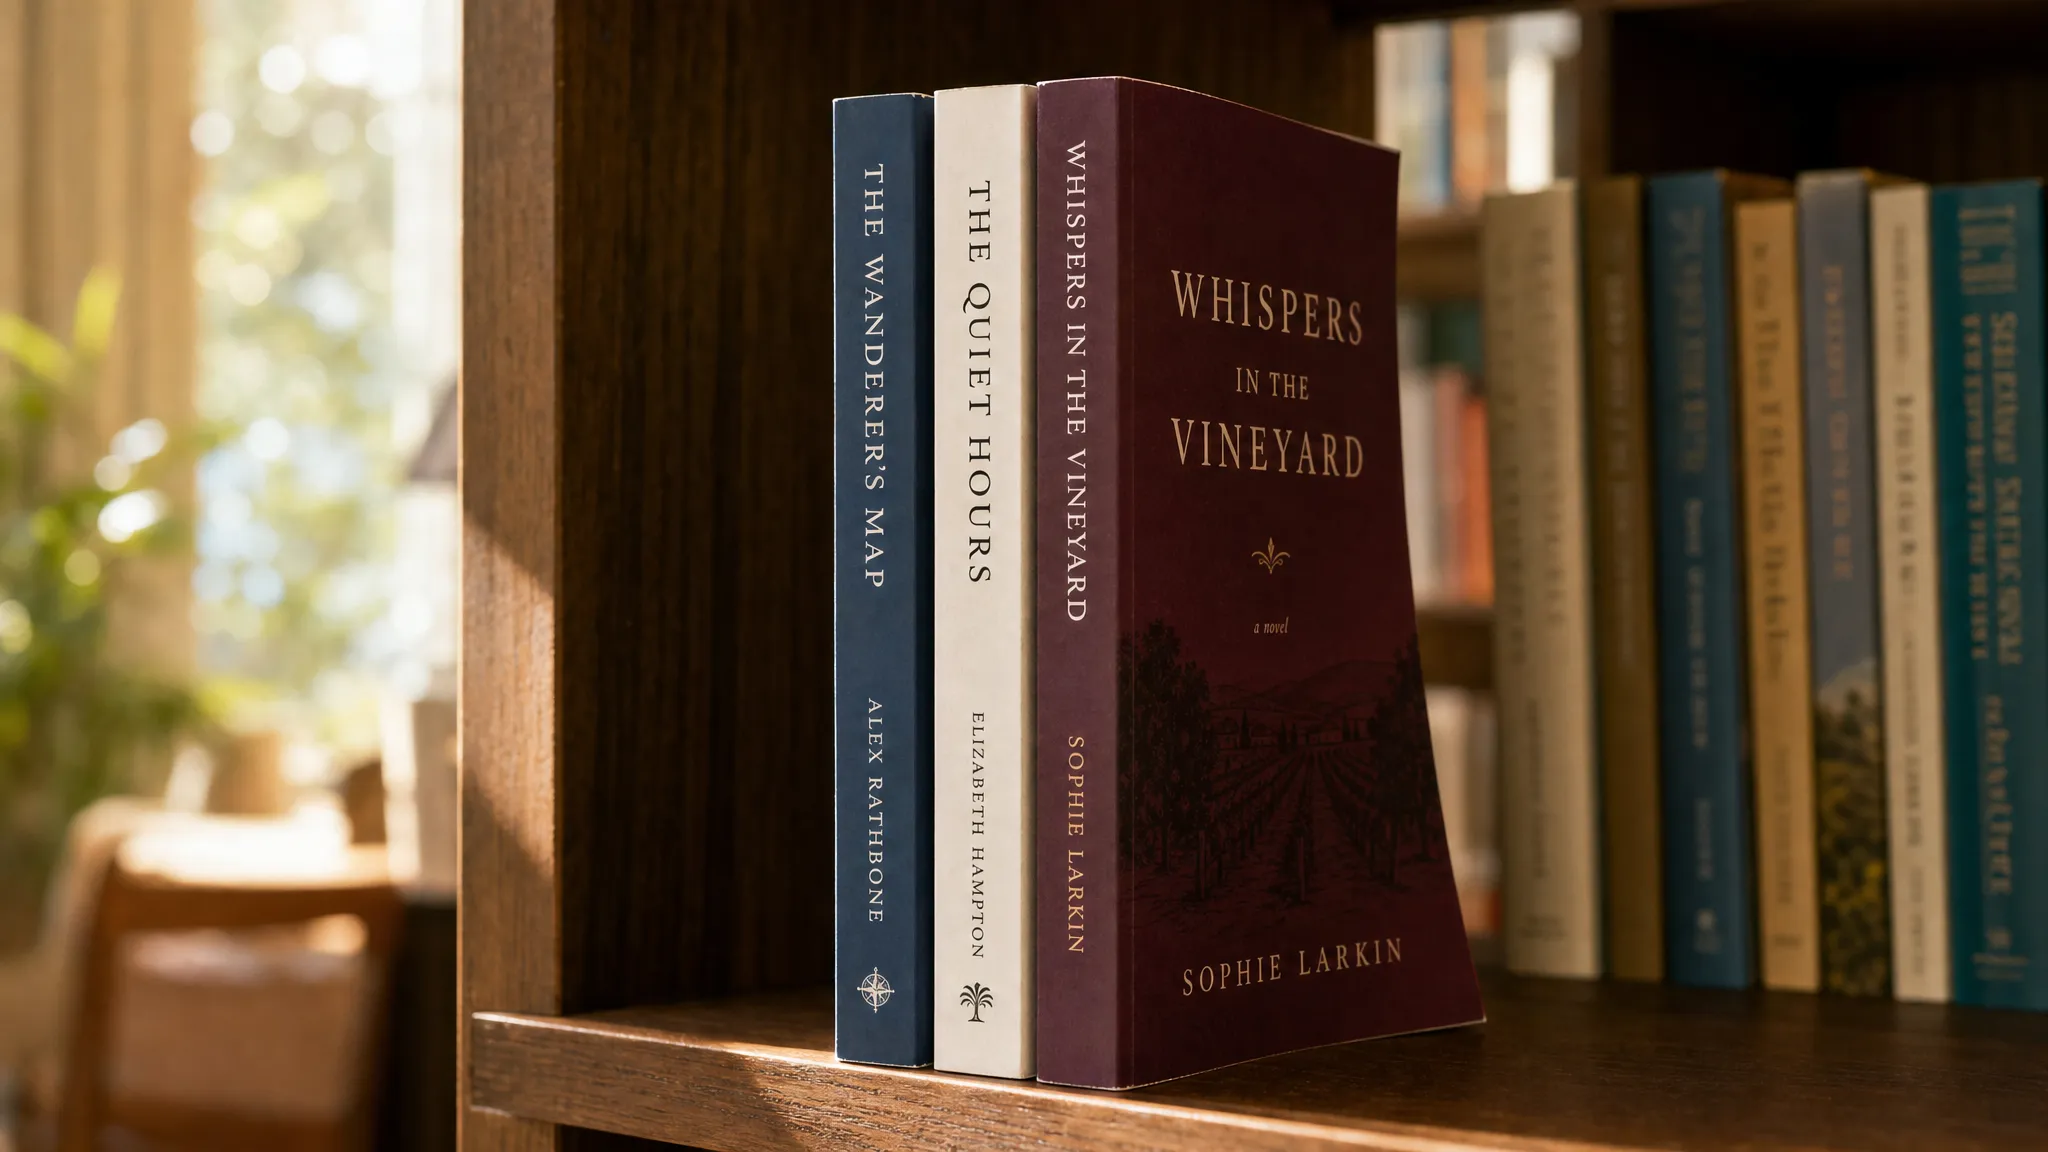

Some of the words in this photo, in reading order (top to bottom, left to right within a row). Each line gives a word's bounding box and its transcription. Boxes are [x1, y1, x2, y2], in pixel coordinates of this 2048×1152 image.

[864, 163, 884, 237] THE
[968, 180, 991, 263] THE
[1066, 139, 1086, 310] WHISPERS
[1066, 322, 1086, 357] IN
[1170, 269, 1362, 346] WHISPERS
[864, 253, 886, 490] WANDERER'S
[962, 282, 991, 417] QUIET
[1236, 367, 1260, 395] IN
[1268, 371, 1309, 401] THE
[1066, 369, 1086, 435] THE
[1170, 417, 1363, 478] VINEYARD
[865, 507, 885, 588] MAP
[968, 435, 991, 583] HOURS
[1067, 448, 1087, 622] VINEYARD
[1253, 623, 1260, 634] a
[1263, 616, 1289, 634] novel
[868, 697, 883, 764] ALEX
[971, 712, 985, 835] ELIZABETH
[1068, 736, 1085, 836] SOPHIE
[868, 776, 884, 922] RATHBONE
[971, 847, 985, 958] HAMPTON
[1067, 849, 1084, 954] LARKIN
[1182, 953, 1282, 997] SOPHIE
[1298, 937, 1401, 976] LARKIN
